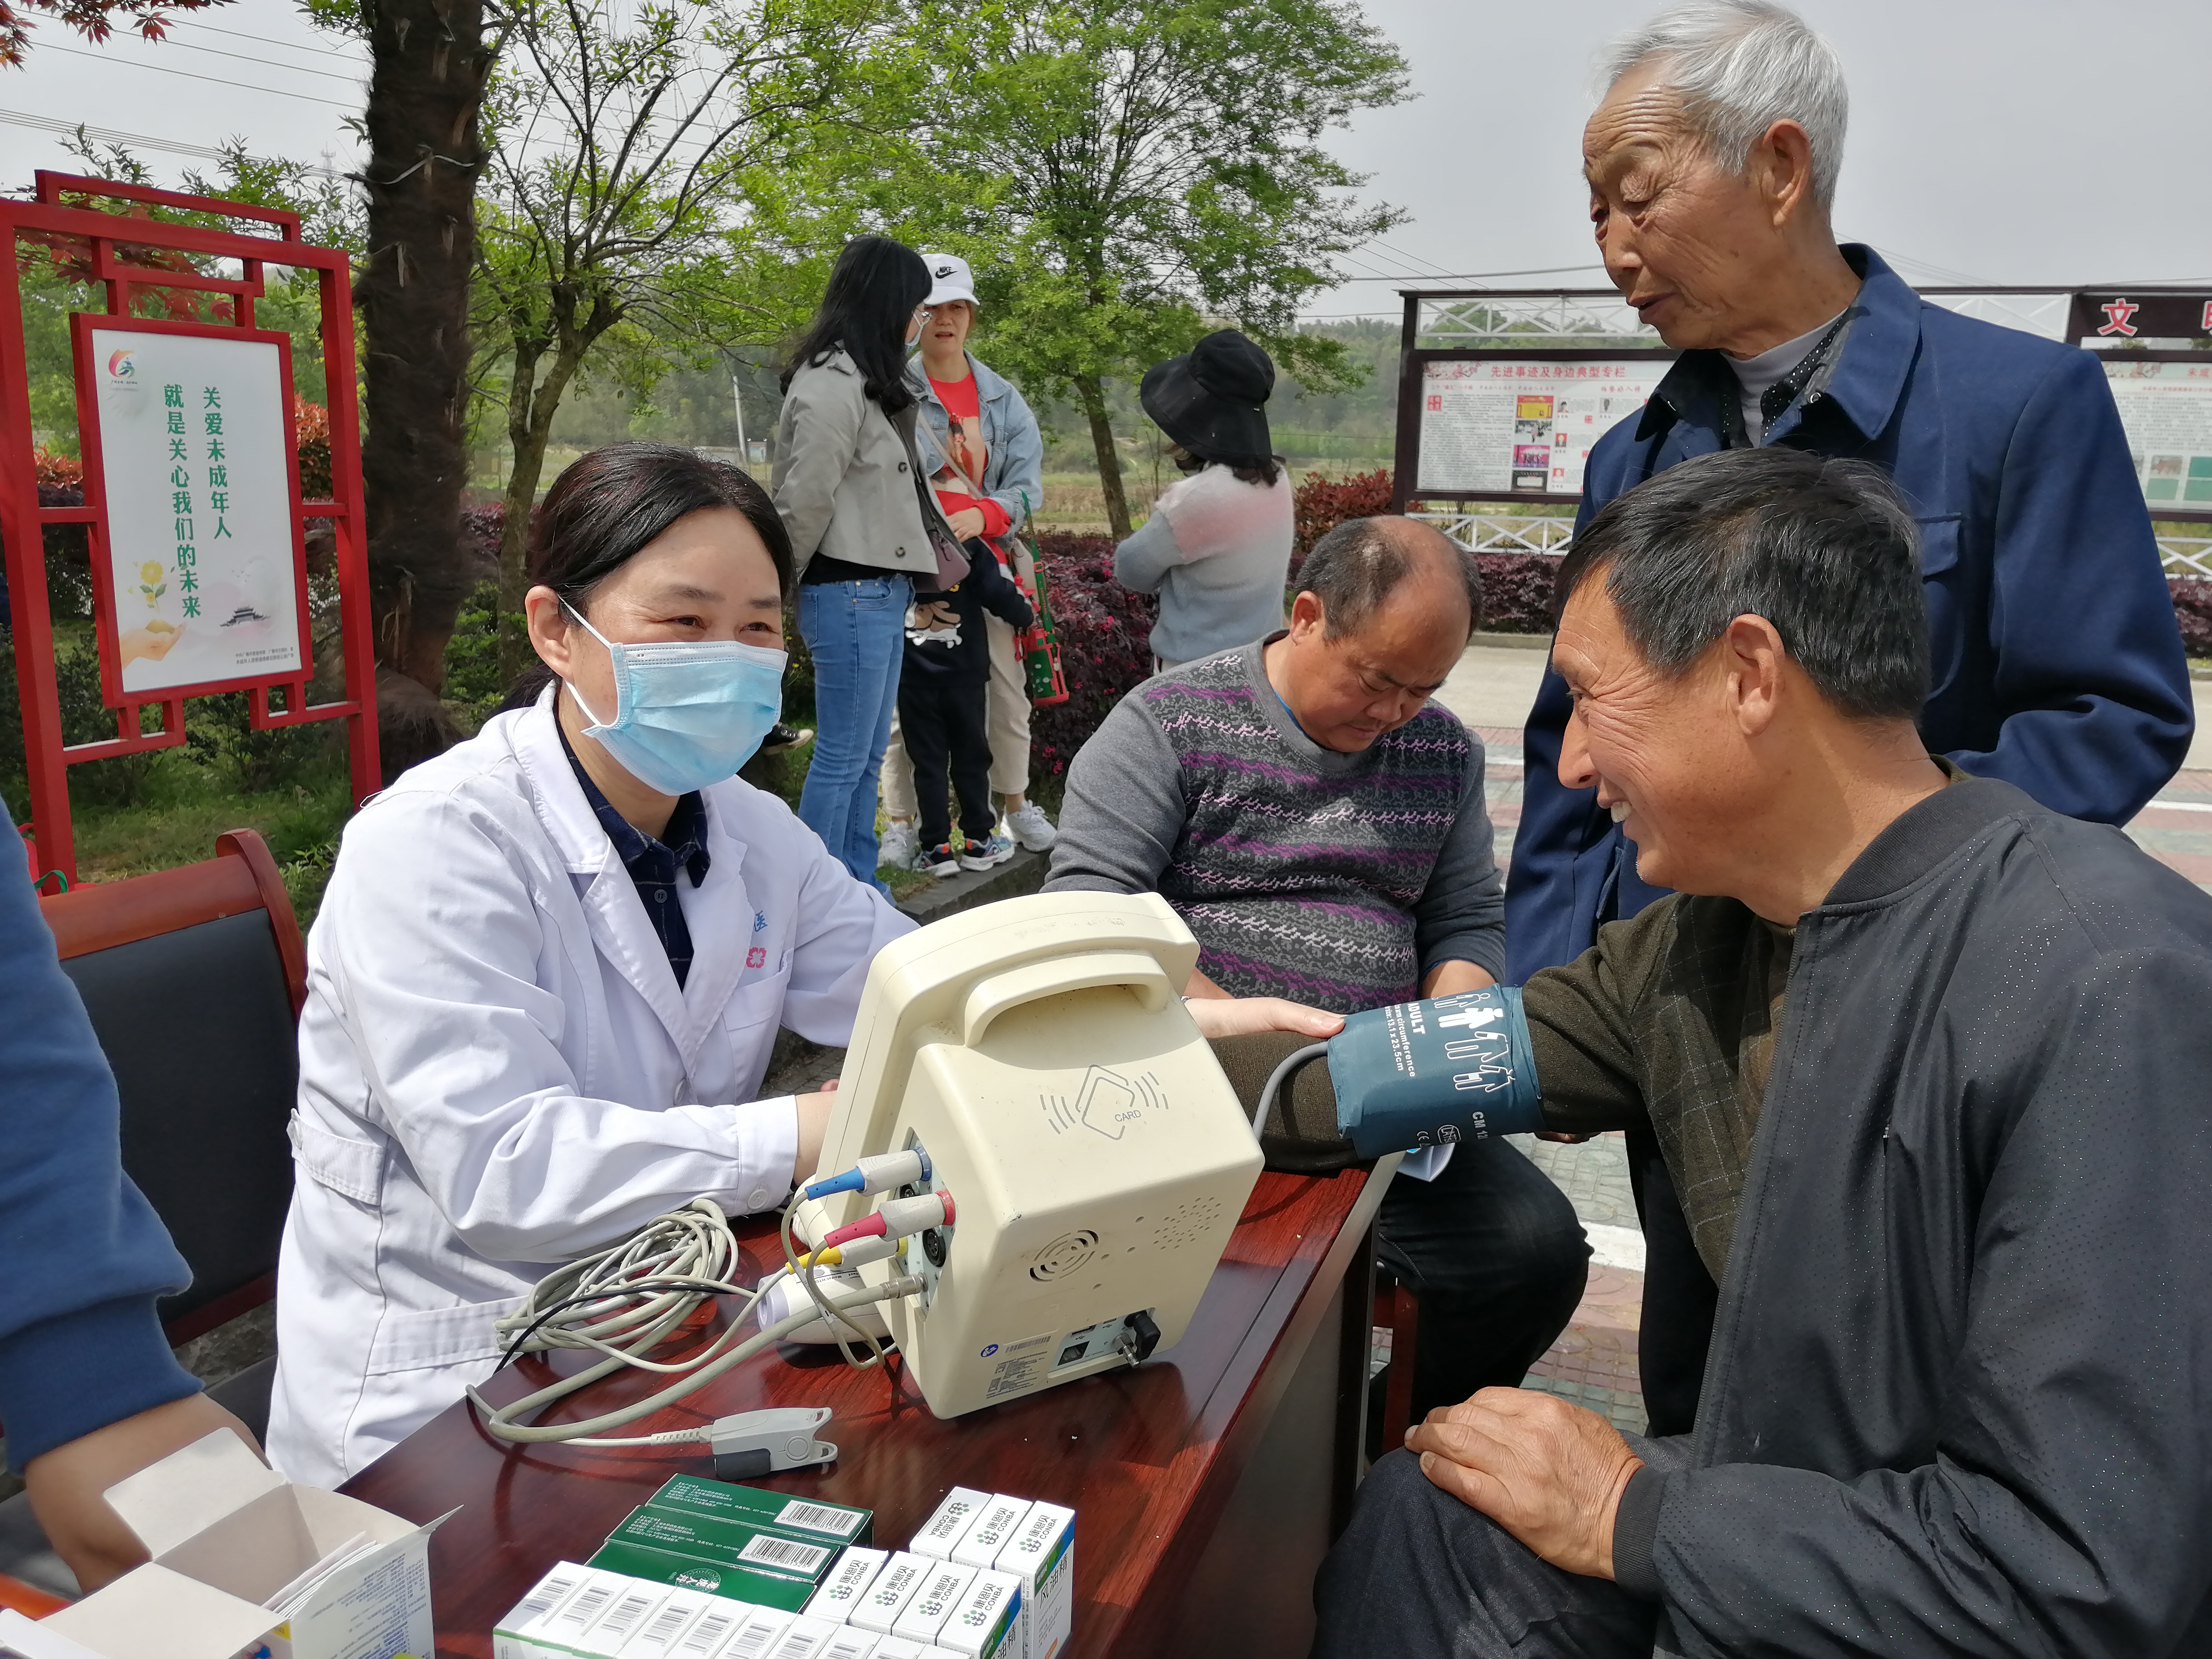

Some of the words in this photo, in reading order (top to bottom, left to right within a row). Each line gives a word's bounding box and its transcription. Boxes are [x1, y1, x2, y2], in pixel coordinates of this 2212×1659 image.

[1490, 365, 1626, 378] 先进事迹及身边典型专栏
[203, 386, 232, 540] 关爱未成年人
[163, 383, 201, 620] 就是关心我们的未来
[1387, 1018, 1396, 1032] 13.1
[1407, 1002, 1425, 1034] ADULT
[1391, 1039, 1404, 1071] 23.5cm
[1397, 1018, 1415, 1077] circumference
[1114, 1109, 1141, 1122] CARD
[1472, 1111, 1486, 1128] CM
[928, 1514, 950, 1536] CONBA
[938, 1516, 960, 1539] 康恩贝
[986, 1507, 1008, 1530] 康恩贝
[997, 1510, 1017, 1532] CONBA
[1028, 1515, 1051, 1538] 康恩贝
[1040, 1519, 1058, 1540] CONBA
[676, 1573, 720, 1590] 龙虎人丹
[839, 1560, 863, 1584] 康恩贝
[851, 1561, 871, 1585] CONBA
[885, 1565, 910, 1590] 康恩贝
[897, 1569, 918, 1592] CONBA
[1039, 1553, 1068, 1609] 风油精
[929, 1575, 953, 1599] 康恩贝
[941, 1577, 961, 1601] CONBA
[973, 1583, 996, 1609] 康恩贝
[985, 1587, 1004, 1611] CONBA
[994, 1623, 1016, 1659] 油精
